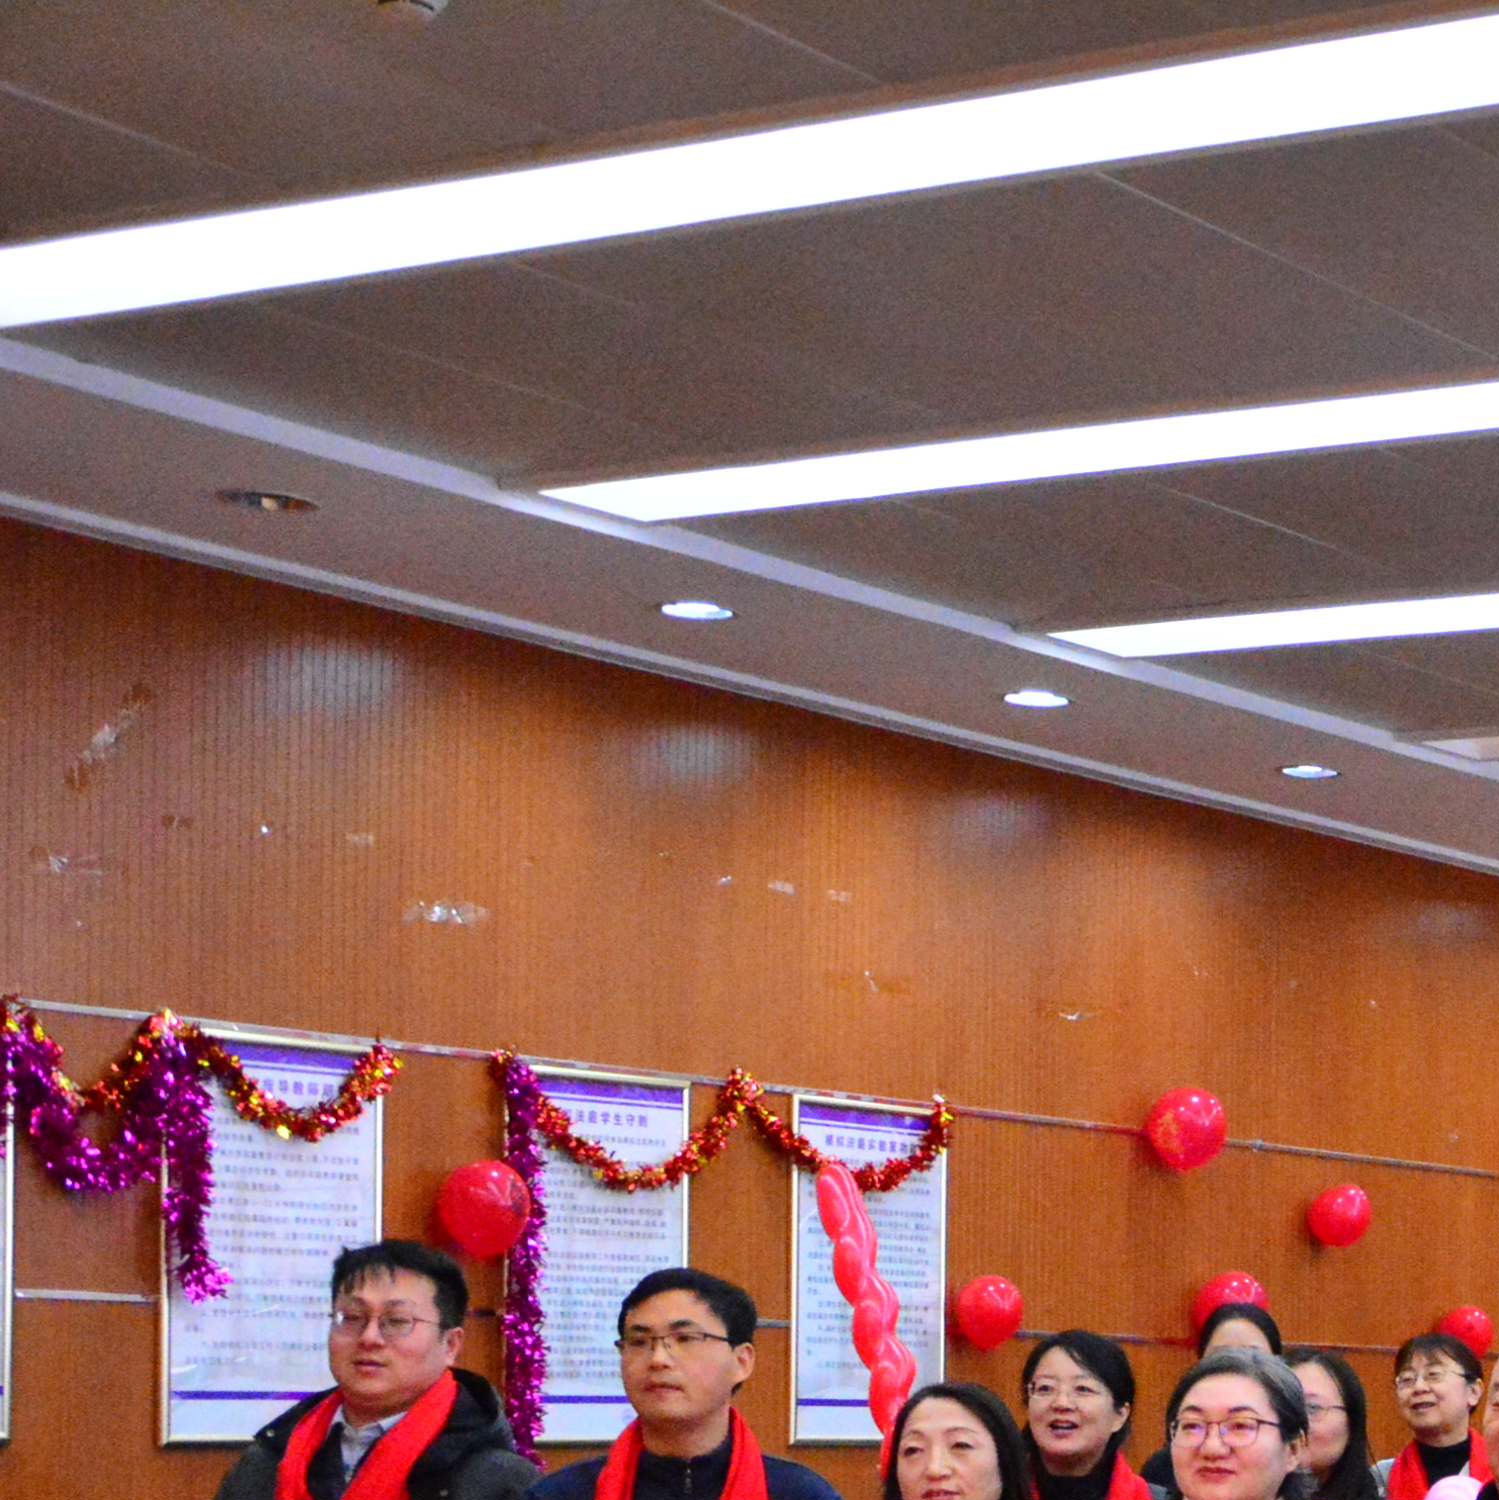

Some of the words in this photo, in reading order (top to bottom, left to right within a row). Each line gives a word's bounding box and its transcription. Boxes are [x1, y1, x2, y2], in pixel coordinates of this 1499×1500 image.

[563, 1107, 648, 1128] 法庭学生守则
